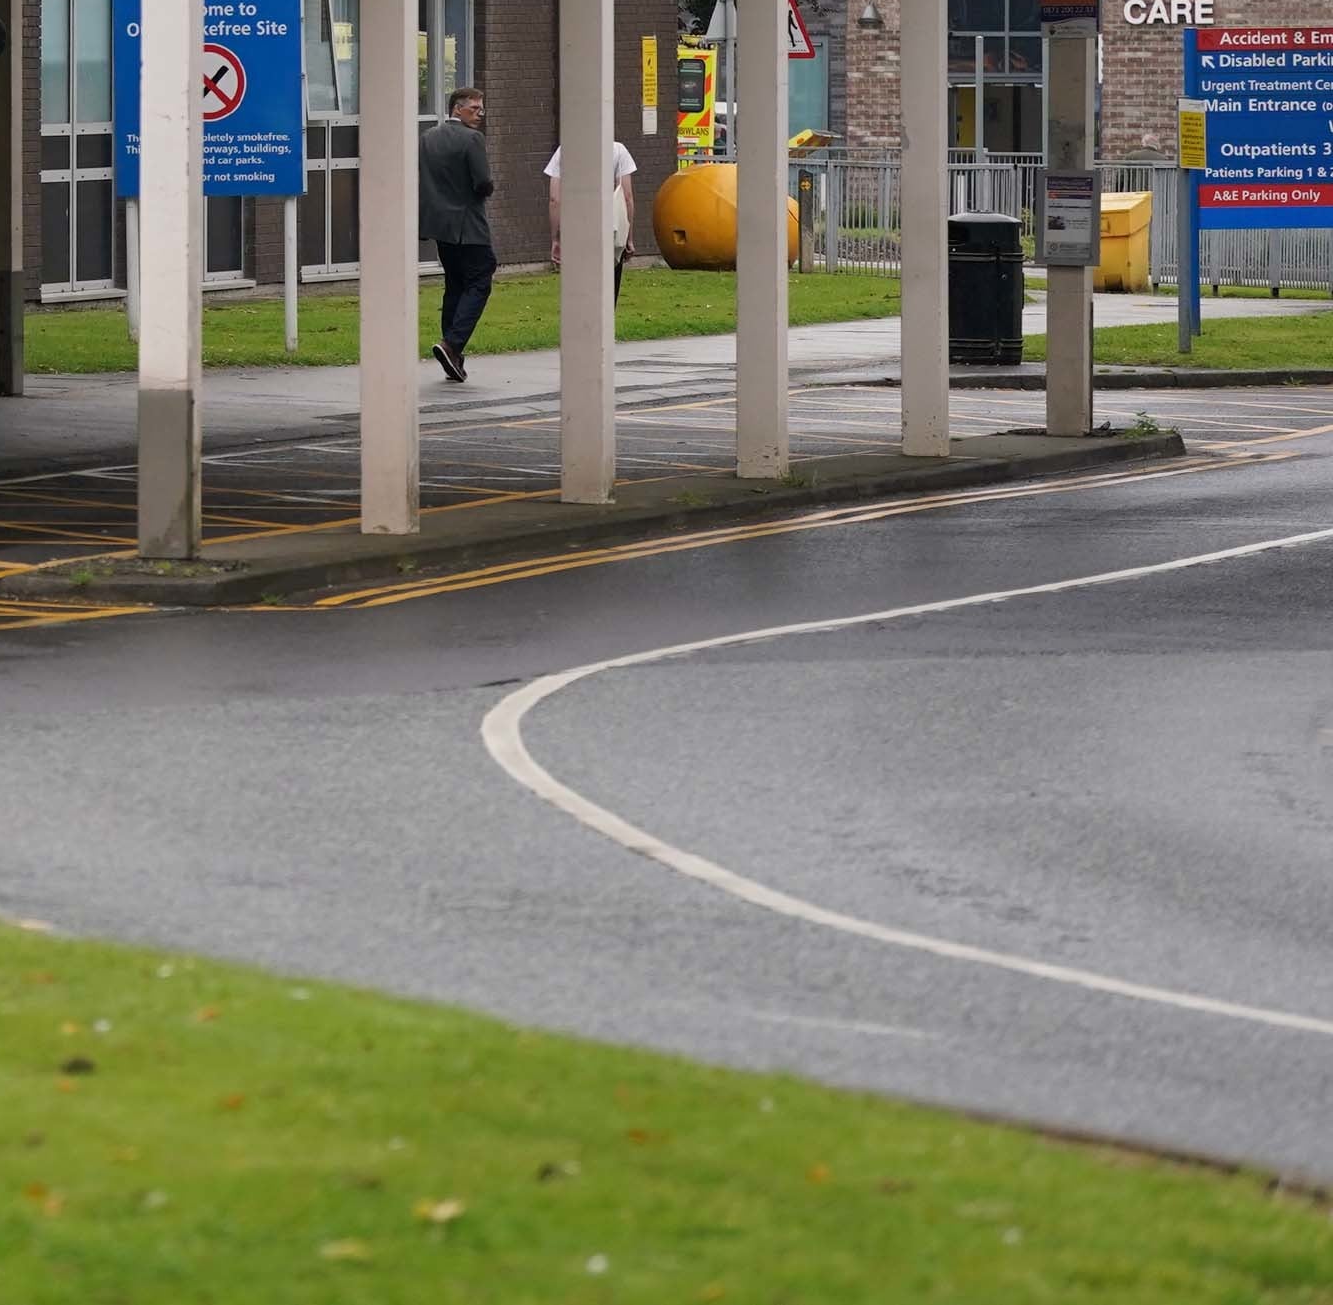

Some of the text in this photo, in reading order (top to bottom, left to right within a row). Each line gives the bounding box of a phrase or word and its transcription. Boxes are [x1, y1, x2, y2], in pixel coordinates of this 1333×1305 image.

[238, 2, 257, 16] to
[1123, 0, 1215, 25] CARE
[204, 21, 288, 36] kefree Site
[1220, 31, 1333, 45] Accident & Em
[1219, 52, 1333, 67] Disabled Parki
[1201, 80, 1245, 94] Urgent
[1248, 80, 1313, 91] Treatment
[1204, 99, 1242, 112] Main
[1249, 99, 1317, 112] Entrance
[126, 133, 140, 143] Th
[237, 132, 291, 142] smokefree.
[125, 143, 292, 156] Thi orways, buildings,
[1221, 142, 1332, 159] Outpatients 3
[203, 156, 265, 166] nd car parks.
[202, 171, 275, 183] or not smoking
[1205, 167, 1254, 178] Patients
[1257, 166, 1303, 180] Parking
[1307, 167, 1313, 177] 1
[1317, 167, 1327, 177] &
[1213, 189, 1321, 203] A&E Parking Only
